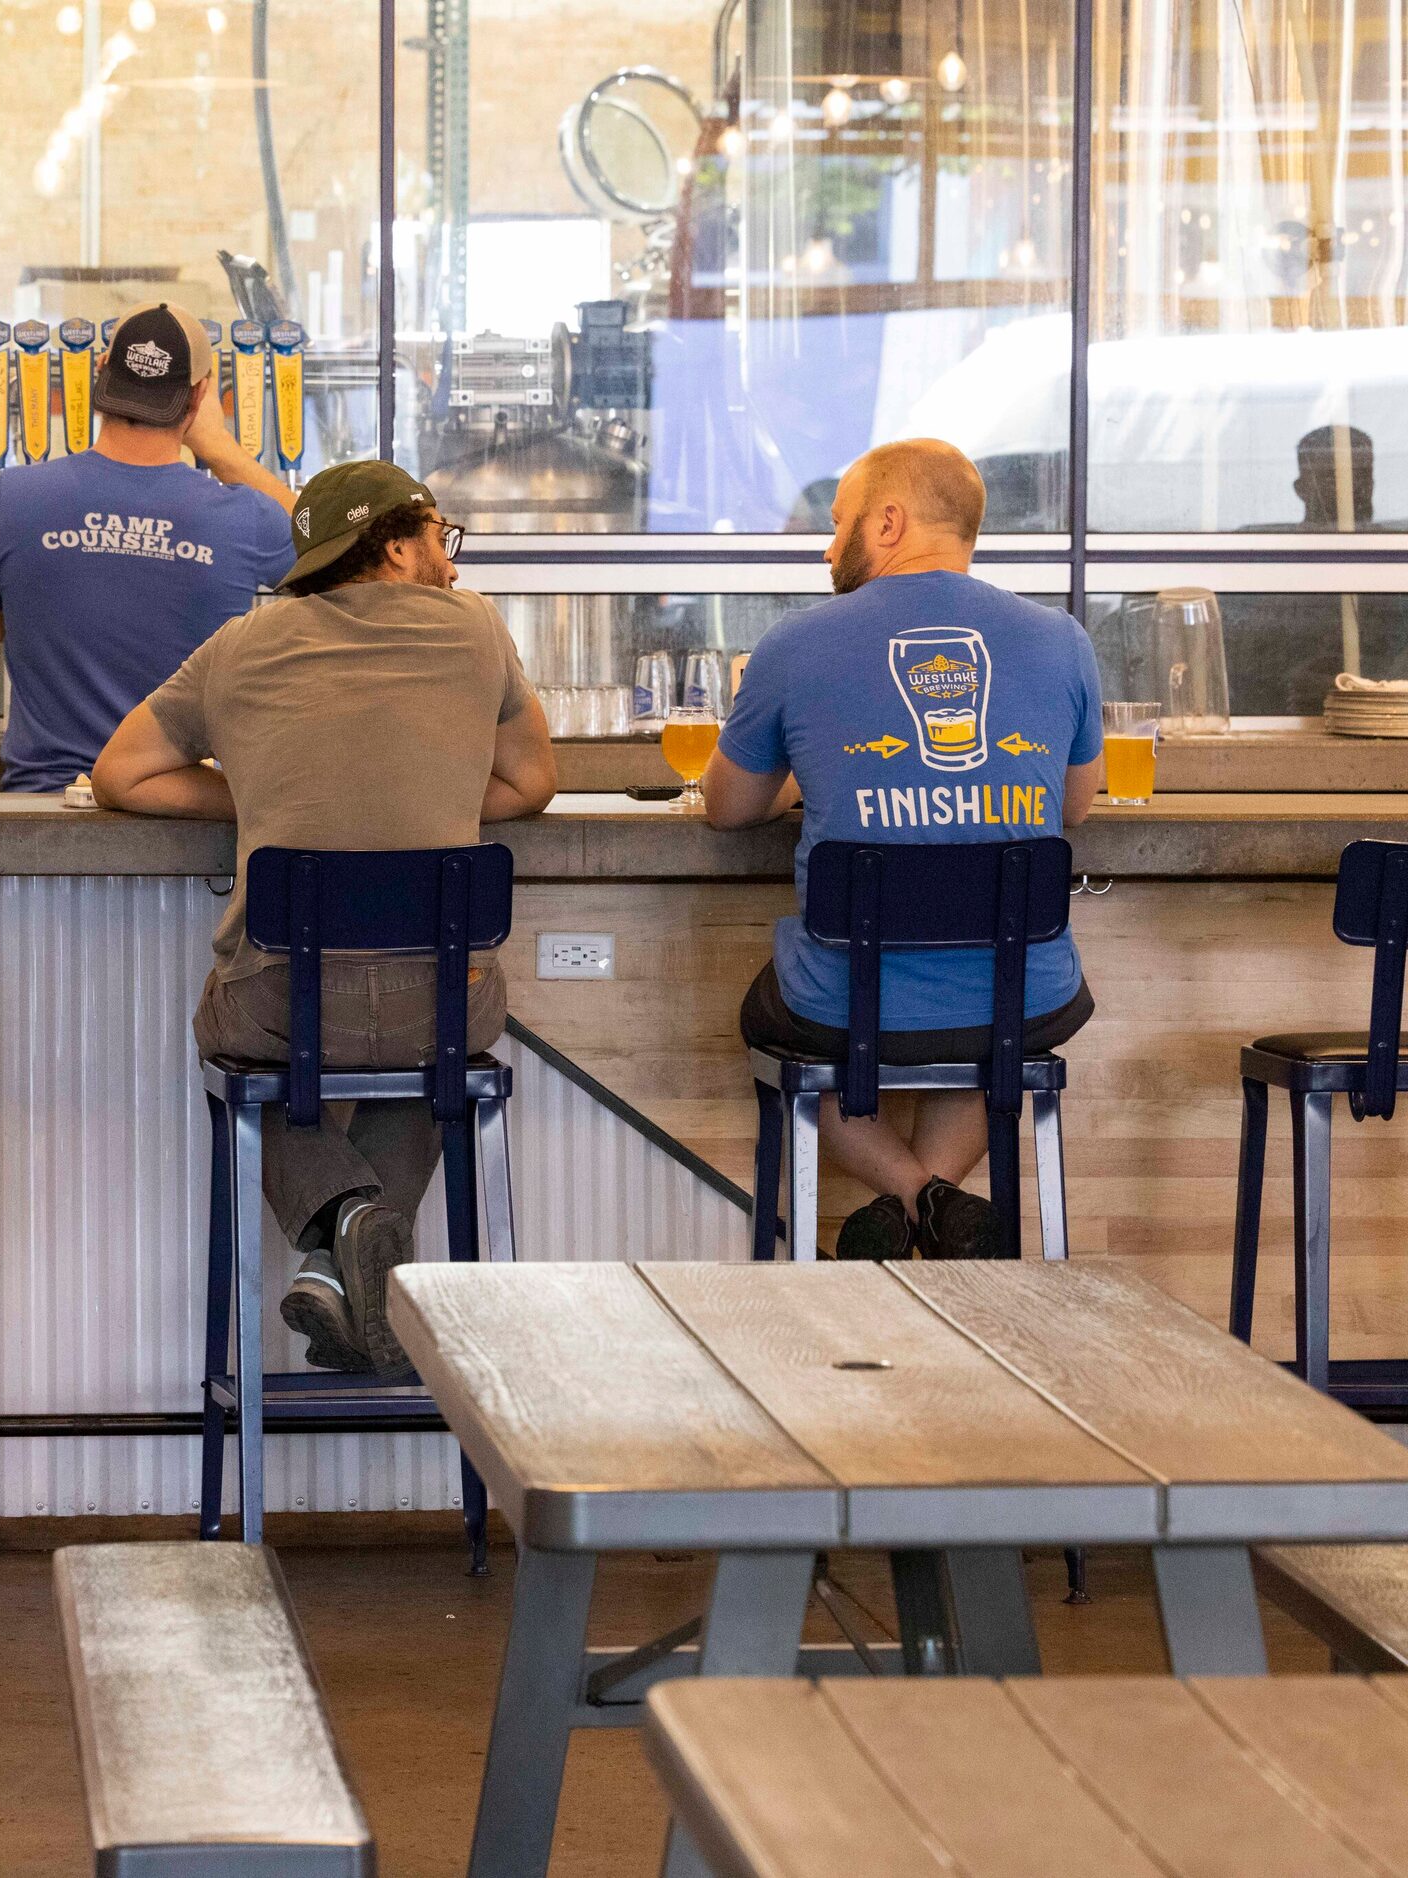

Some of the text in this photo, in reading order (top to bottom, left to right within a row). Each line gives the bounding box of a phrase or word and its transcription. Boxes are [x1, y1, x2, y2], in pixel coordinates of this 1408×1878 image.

[61, 328, 92, 336] WESTLAKE
[126, 350, 172, 369] WESTLAKE
[31, 387, 40, 429] THIS MANY
[84, 512, 174, 537] CAMP
[42, 529, 214, 566] COUNSELOR
[908, 671, 979, 685] WESTLAKE
[923, 684, 968, 694] BREWING
[856, 784, 1048, 828] FINISHLINE
